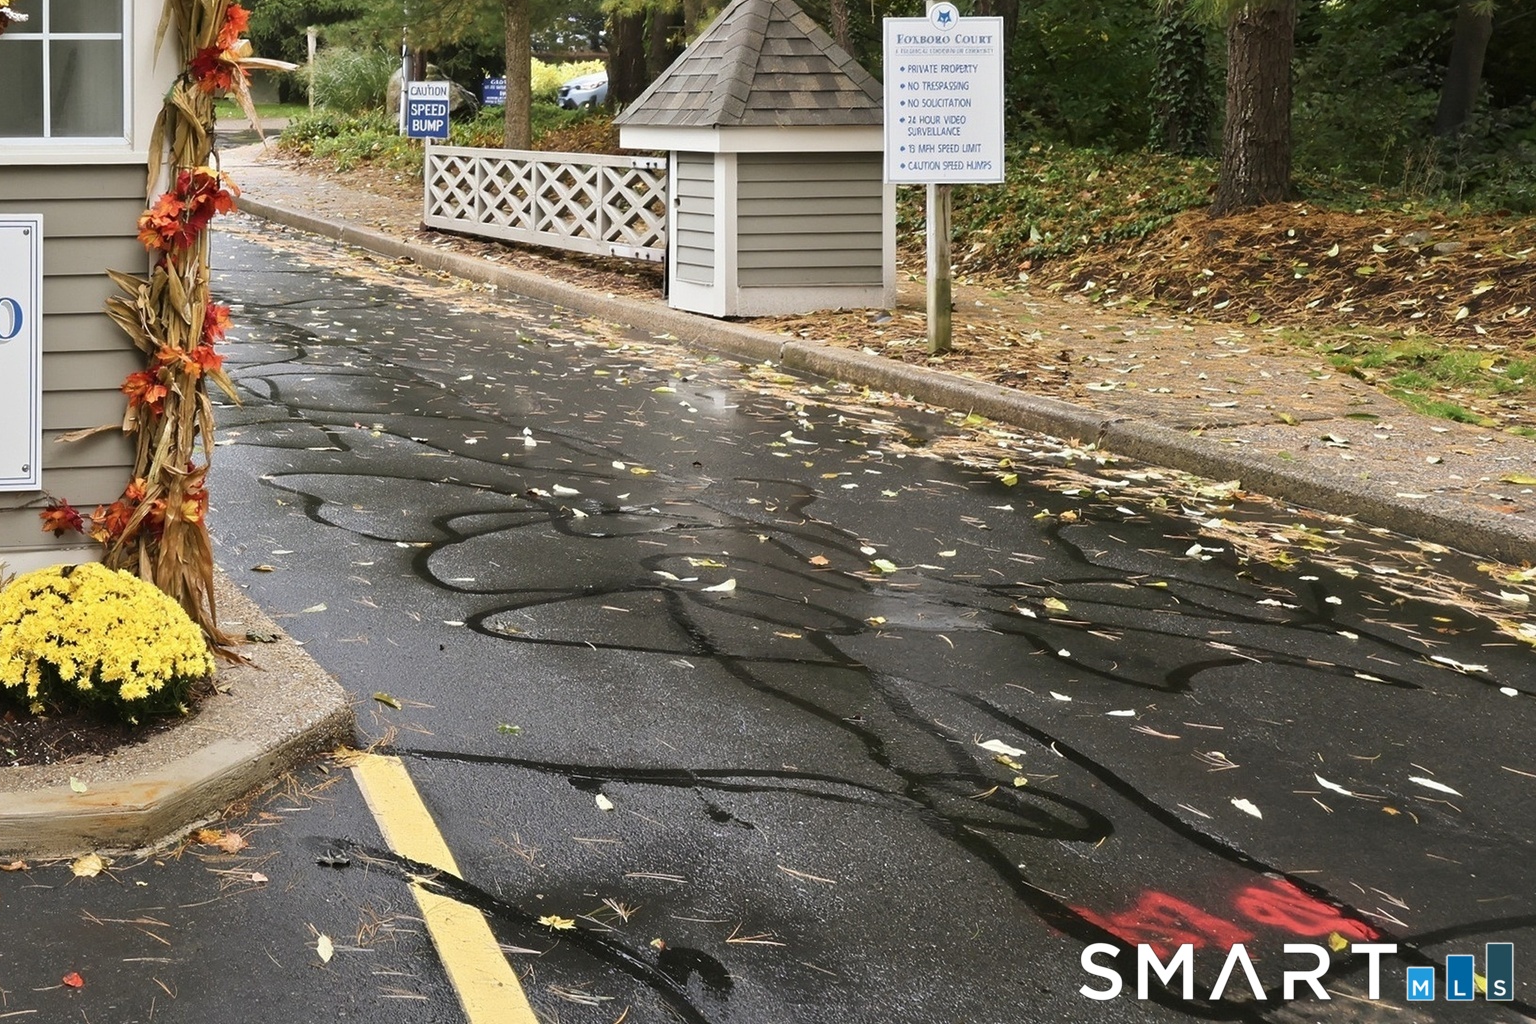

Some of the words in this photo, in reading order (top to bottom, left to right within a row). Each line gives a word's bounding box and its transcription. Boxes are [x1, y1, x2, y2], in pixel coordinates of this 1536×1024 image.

[955, 34, 993, 44] COURT
[907, 64, 938, 73] PRIVATE
[940, 64, 978, 73] PROPERTY
[907, 81, 920, 90] NO
[922, 81, 970, 90] TRESPASSING
[410, 86, 447, 96] CAUTION
[907, 98, 920, 107] NO
[922, 98, 972, 107] SOLICITATION
[411, 104, 446, 116] SPEED
[919, 115, 941, 124] HOUR
[943, 115, 967, 124] VIDEO
[412, 119, 444, 132] BUMP
[907, 126, 961, 136] SURVEILLANCE
[937, 144, 960, 153] SPEED
[962, 144, 981, 153] LIMIT
[907, 161, 941, 170] CAUTION
[942, 161, 965, 170] SPEED
